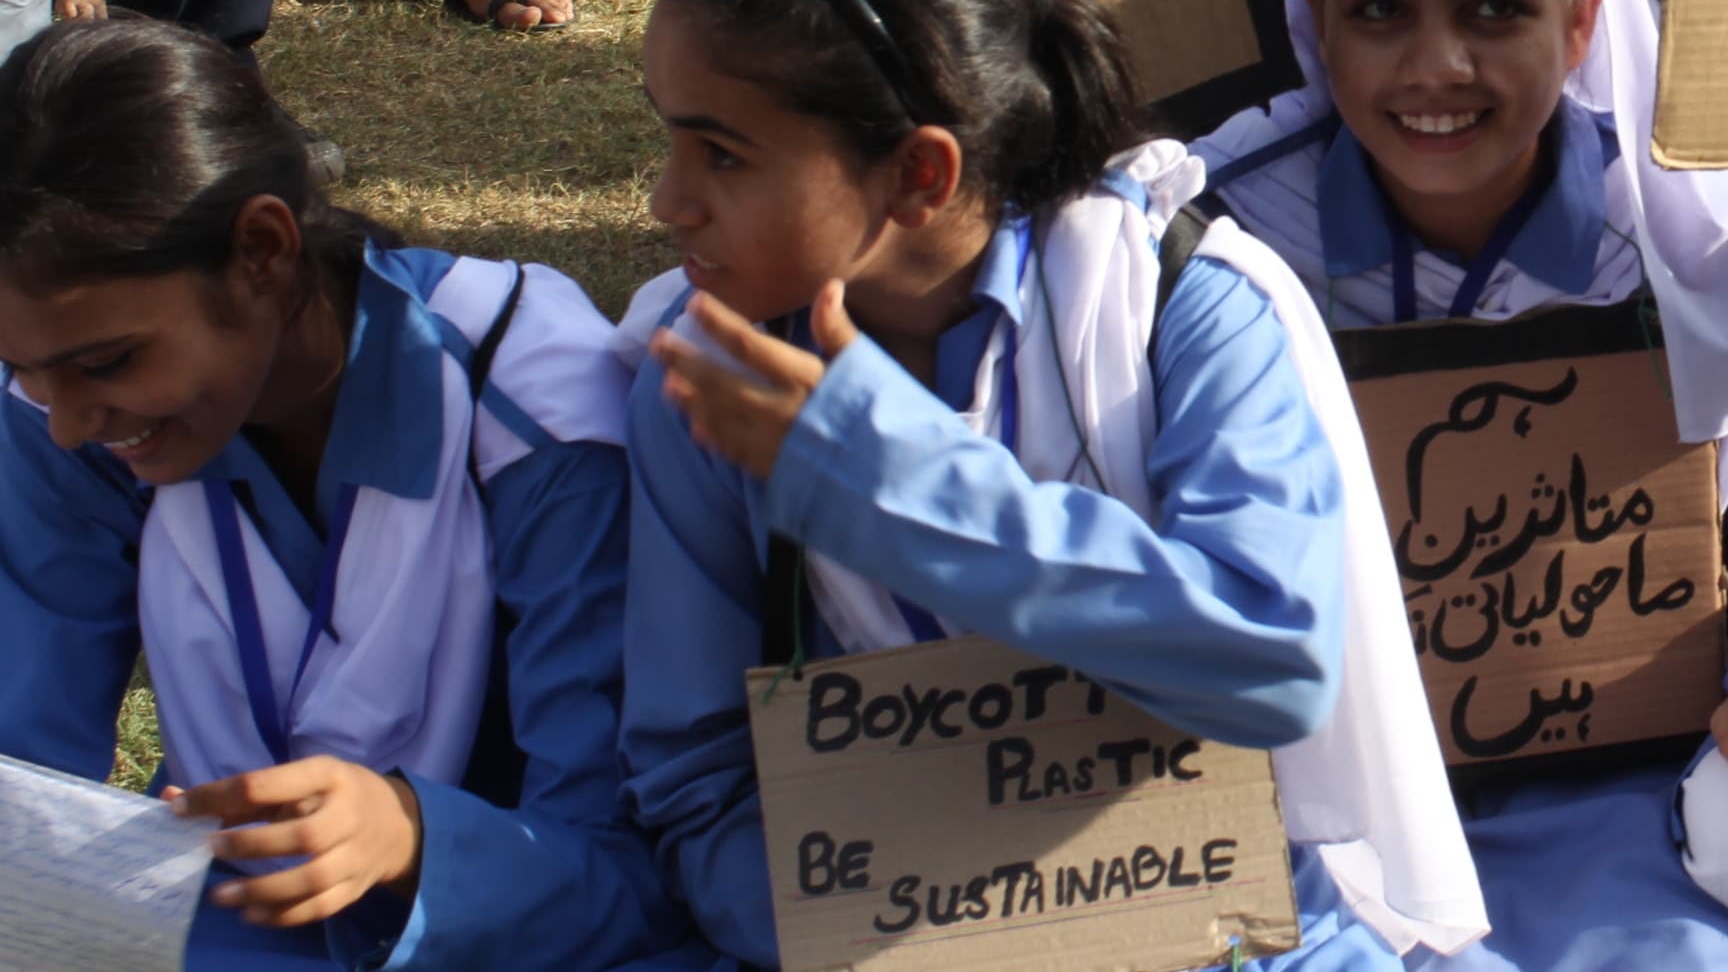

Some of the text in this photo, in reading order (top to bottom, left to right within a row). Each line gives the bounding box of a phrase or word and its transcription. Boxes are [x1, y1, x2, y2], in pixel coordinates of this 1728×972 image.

[1405, 366, 1578, 524] ہم
[1450, 674, 1594, 758] ہیں
[797, 831, 1238, 934] BE SUSTAINABLE
